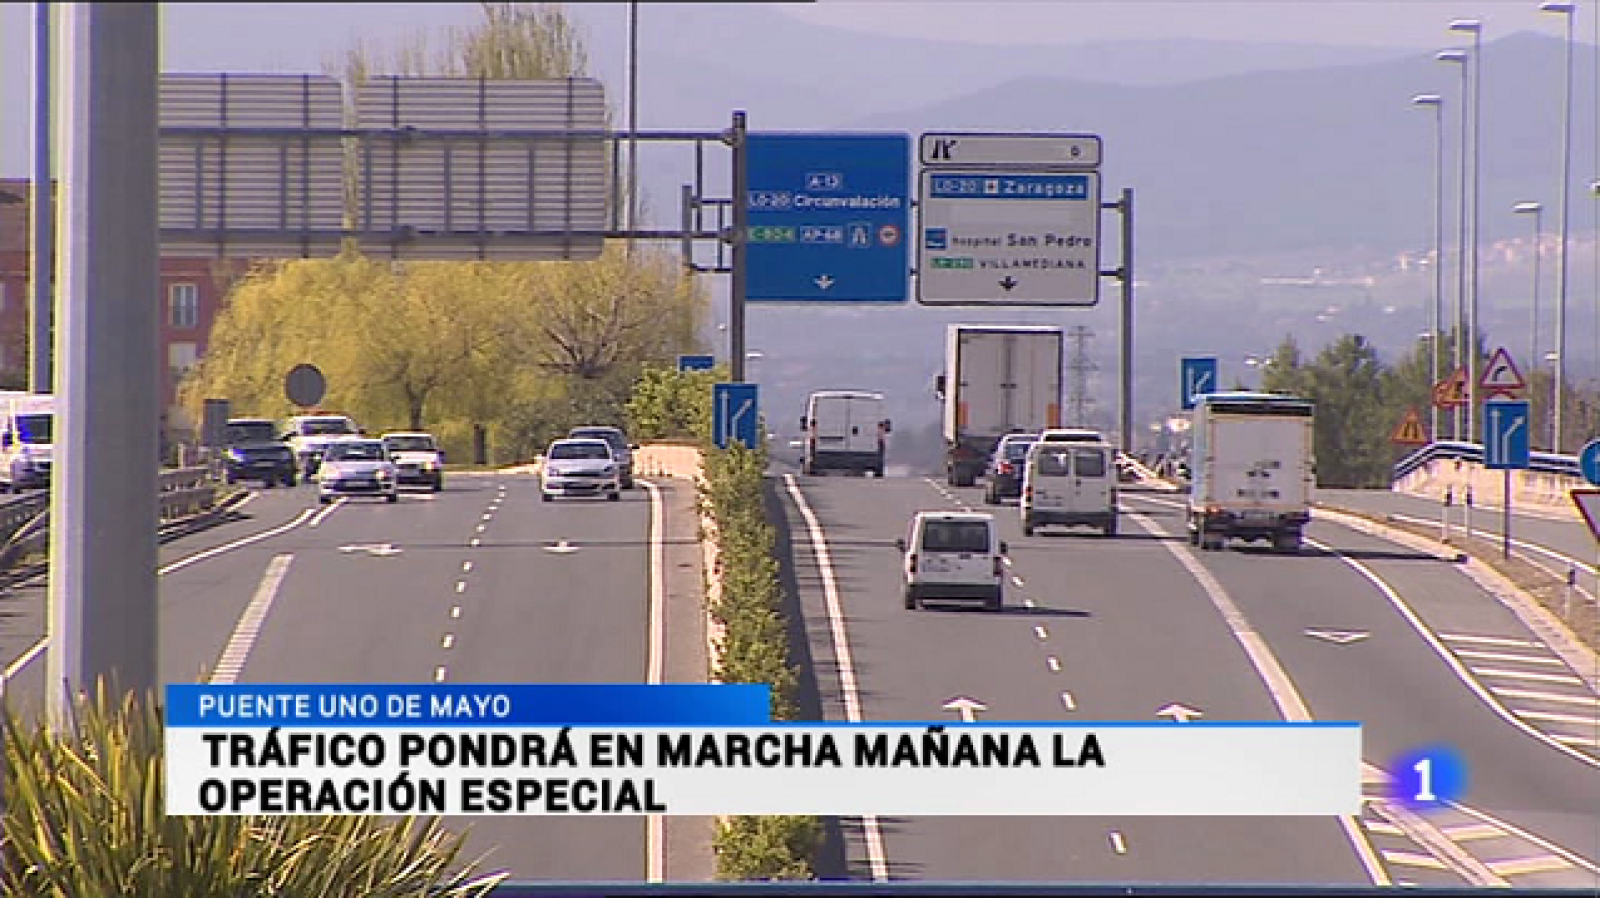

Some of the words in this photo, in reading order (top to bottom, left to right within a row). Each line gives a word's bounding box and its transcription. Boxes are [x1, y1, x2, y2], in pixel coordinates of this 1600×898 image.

[1002, 179, 1084, 197] Zaragoza
[794, 194, 901, 209] Circunvalación
[1007, 233, 1038, 247] San
[1045, 233, 1092, 247] Pedro
[979, 257, 1086, 269] VILLAMEDIANA
